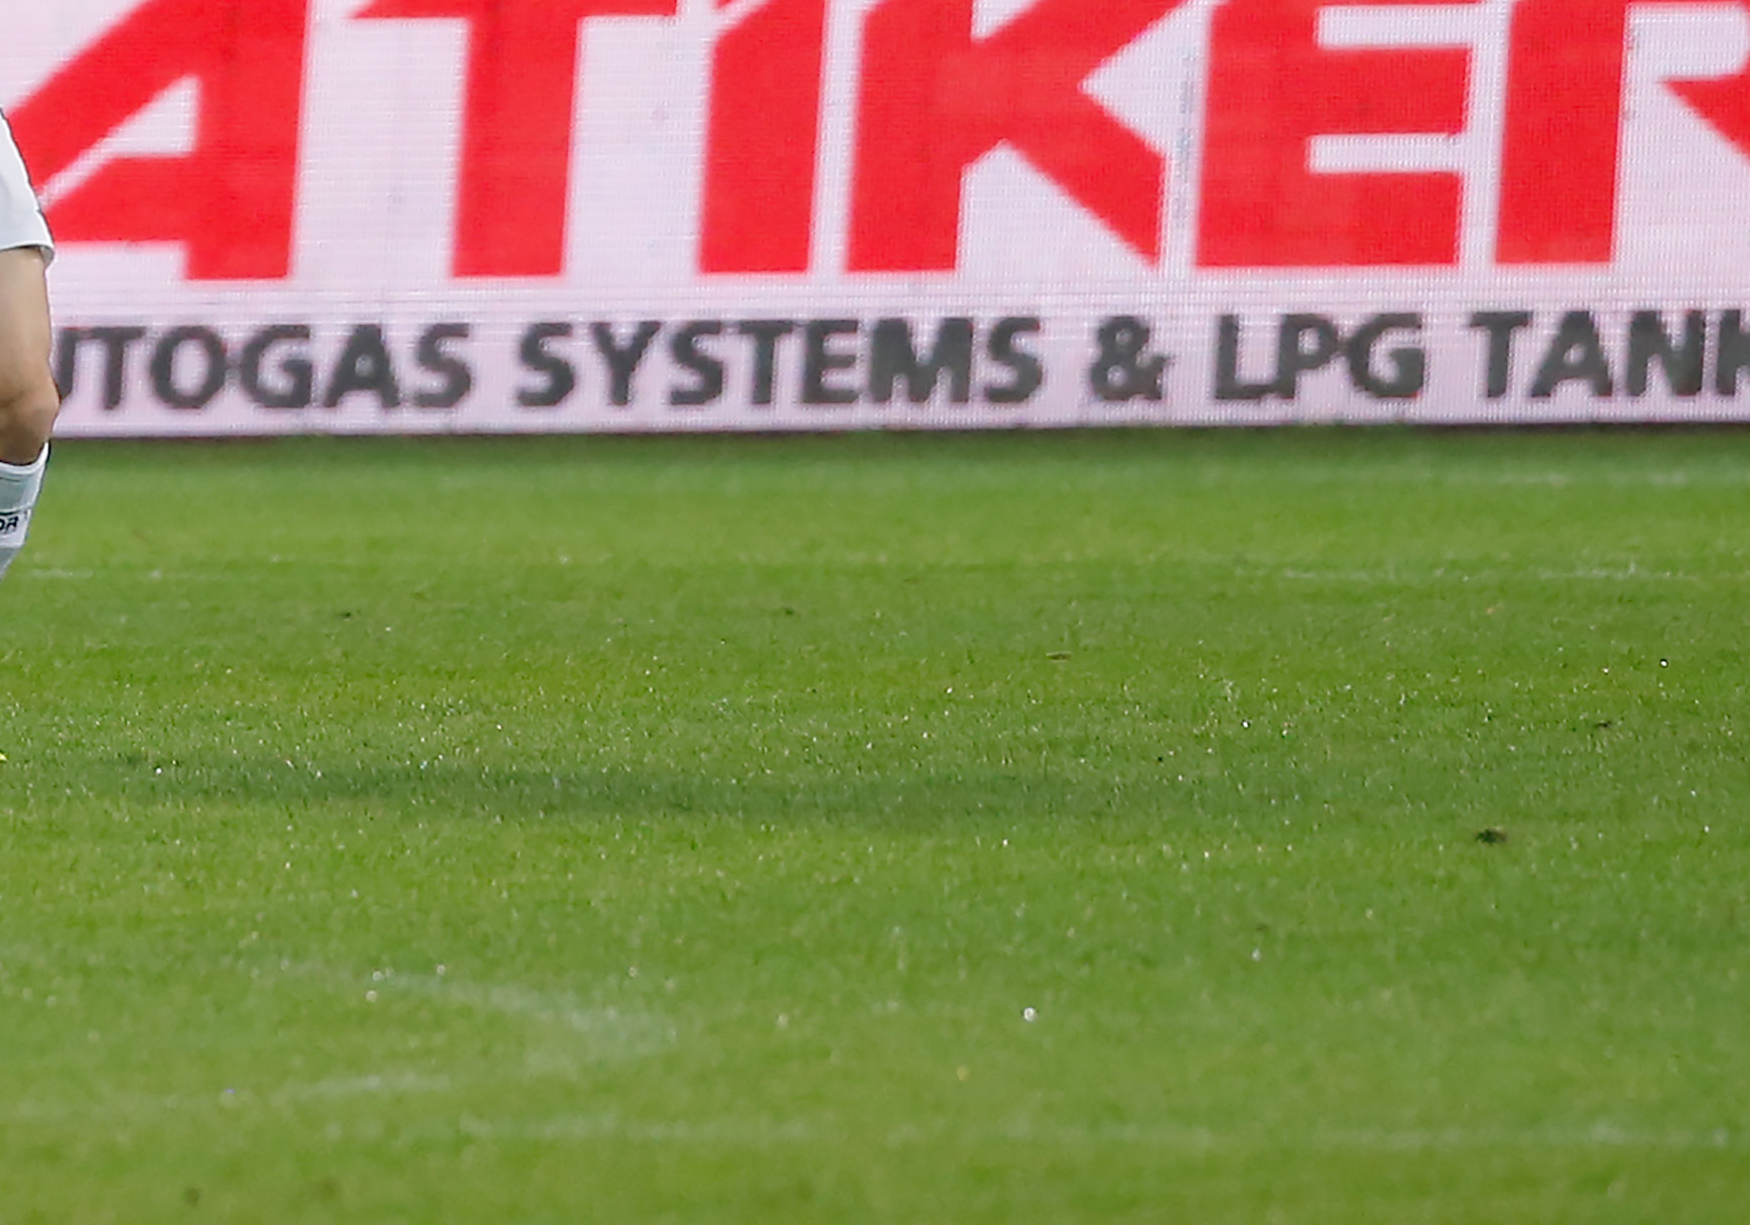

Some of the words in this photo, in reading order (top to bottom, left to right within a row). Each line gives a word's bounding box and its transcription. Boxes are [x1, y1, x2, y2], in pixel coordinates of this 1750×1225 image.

[516, 317, 1044, 409] SYSTEMS
[1086, 314, 1171, 405] &
[1212, 311, 1428, 403] LPG
